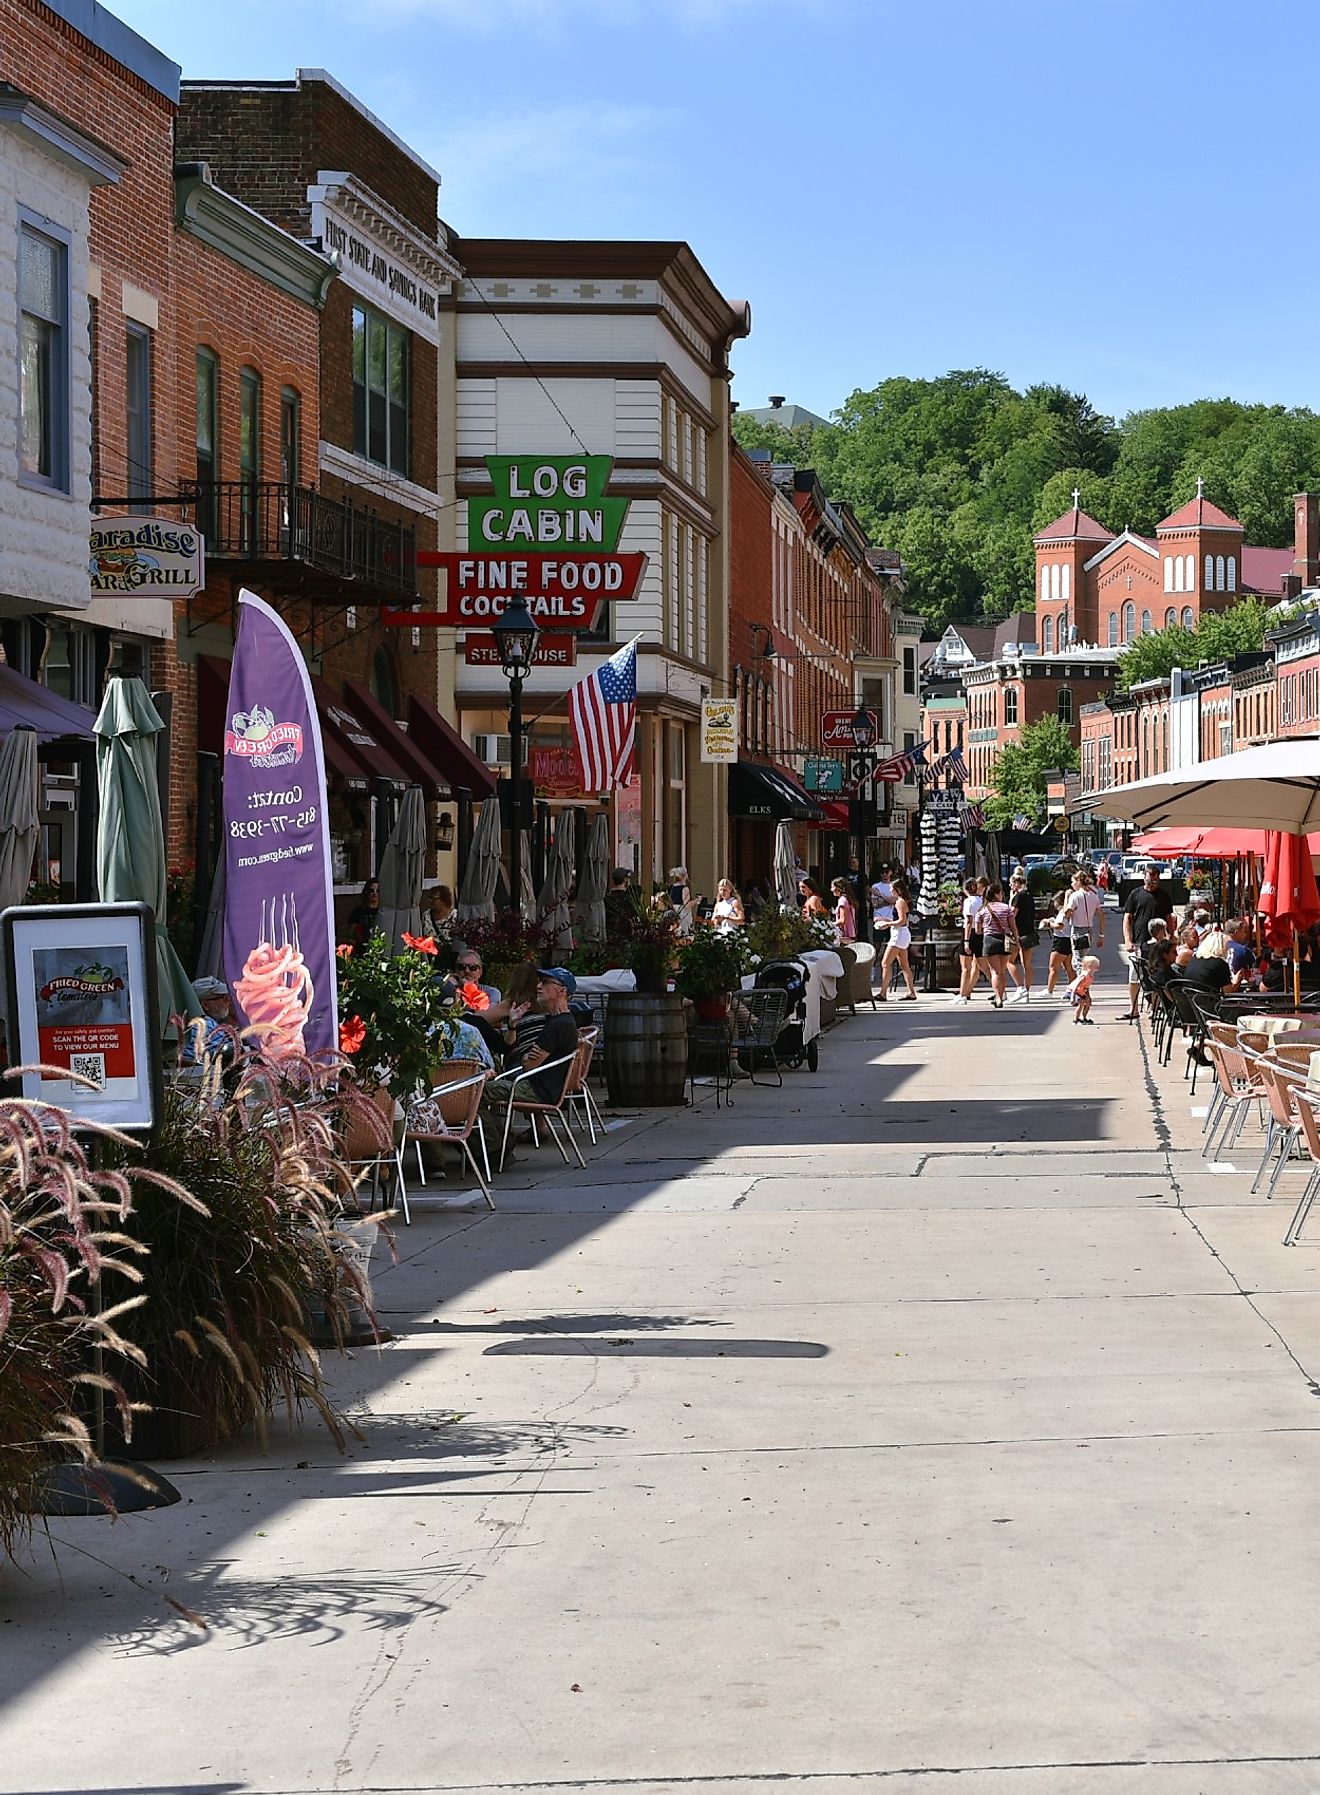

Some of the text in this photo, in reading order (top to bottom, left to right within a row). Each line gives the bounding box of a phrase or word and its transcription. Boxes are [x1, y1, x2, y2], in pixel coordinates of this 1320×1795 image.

[326, 217, 435, 320] FIRST STATE AND SAVINGS BANK
[510, 465, 587, 498] LOG
[90, 524, 197, 555] aradise
[482, 509, 603, 542] CABIN
[90, 575, 117, 590] AR
[459, 561, 623, 590] FINE FOOD
[460, 595, 586, 616] COCTAILS
[749, 806, 771, 814] ELKS
[49, 978, 115, 992] FRIED GREEN
